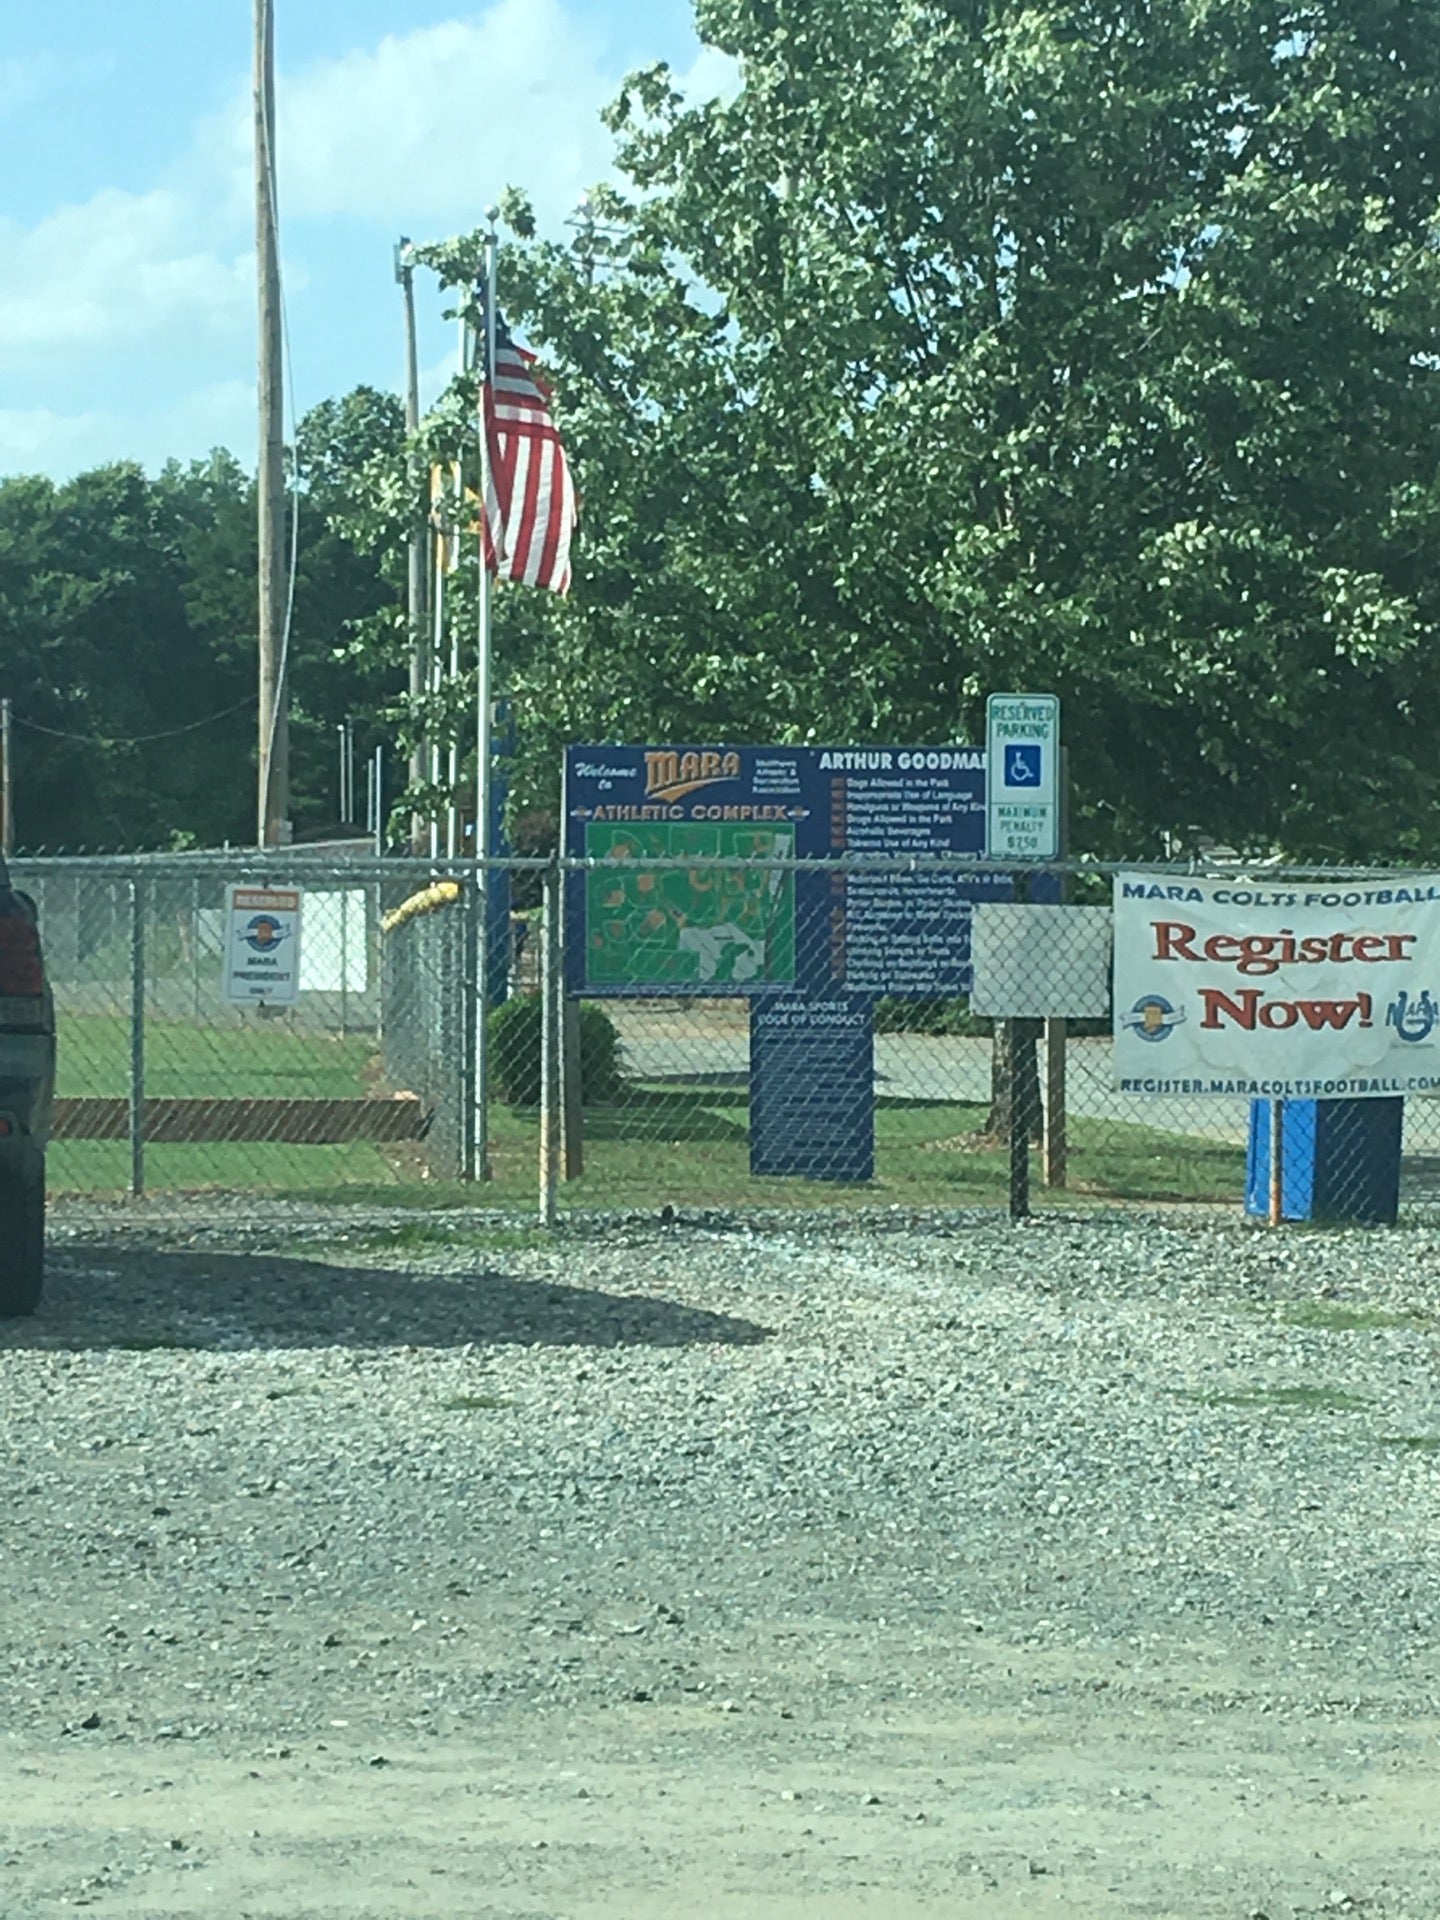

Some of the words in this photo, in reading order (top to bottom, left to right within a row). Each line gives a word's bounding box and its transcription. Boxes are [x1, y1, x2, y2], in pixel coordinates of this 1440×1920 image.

[993, 705, 1054, 721] RESERVED
[996, 722, 1049, 739] PARKING
[819, 752, 893, 770] ARTHUR
[574, 762, 637, 777] Welcome
[644, 750, 741, 795] MARA
[930, 778, 949, 787] Park
[592, 805, 684, 820] ATHLETIC
[691, 805, 788, 820] COMPLEX
[998, 807, 1047, 818] MAXIMUM
[999, 821, 1044, 833] PENALTY
[1006, 836, 1038, 849] $250
[1122, 882, 1204, 903] MARA
[1212, 889, 1297, 907] COLTS
[1304, 886, 1440, 907] FOOTBALL
[1150, 921, 1418, 976] Register
[247, 957, 278, 966] MARA
[808, 1001, 849, 1012] SPORTS
[1197, 988, 1373, 1031] Now!
[791, 1014, 807, 1025] OF
[810, 1014, 866, 1026] CONDUCT
